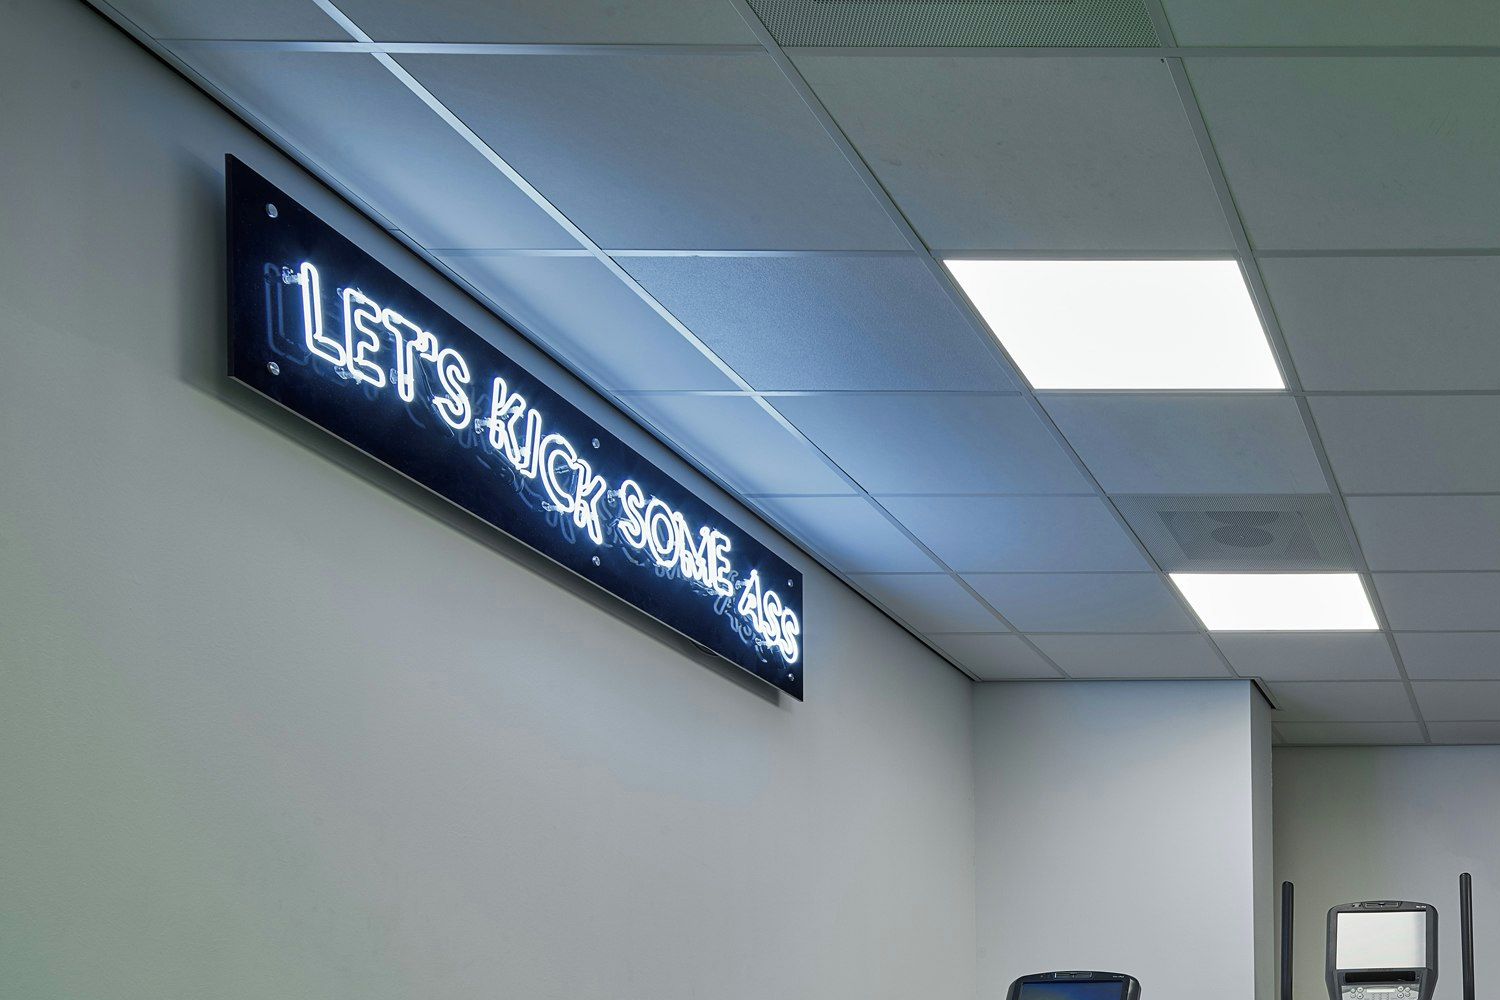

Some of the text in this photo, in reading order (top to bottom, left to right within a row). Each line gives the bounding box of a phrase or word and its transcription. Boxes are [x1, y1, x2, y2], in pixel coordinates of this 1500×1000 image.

[301, 262, 800, 665] LET'S KICK SOME ASS
